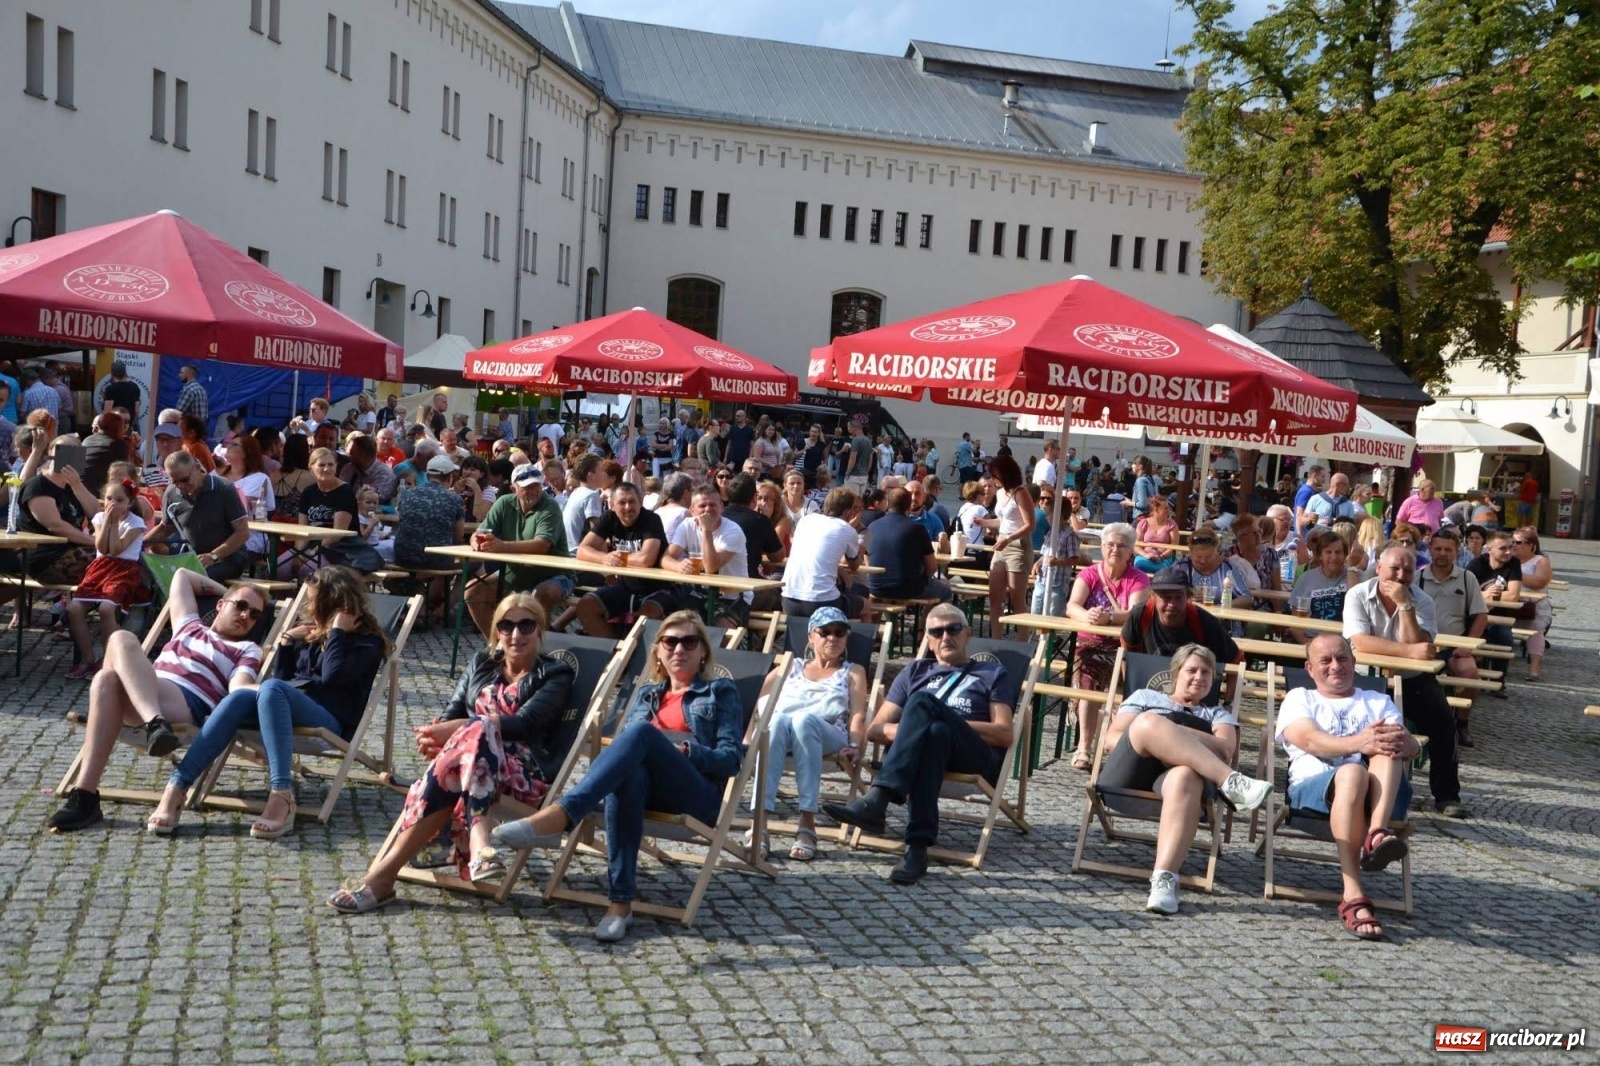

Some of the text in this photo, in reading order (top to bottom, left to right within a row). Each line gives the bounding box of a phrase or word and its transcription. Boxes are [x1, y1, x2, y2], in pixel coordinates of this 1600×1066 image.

[39, 308, 157, 346] RACIBORSKIE
[254, 335, 343, 369] RACIBORSKIE
[473, 360, 544, 377] RACIBORSKIE
[570, 365, 684, 387] RACIBORSKIE
[848, 352, 997, 382] RACIBORSKIE
[710, 376, 787, 397] RACIBORSKIE
[1047, 363, 1230, 404] RACIBORSKIE
[808, 396, 841, 407] TRUCK
[1270, 387, 1350, 422] RACIBORSKIE
[1332, 436, 1406, 460] RACIBORSKIE
